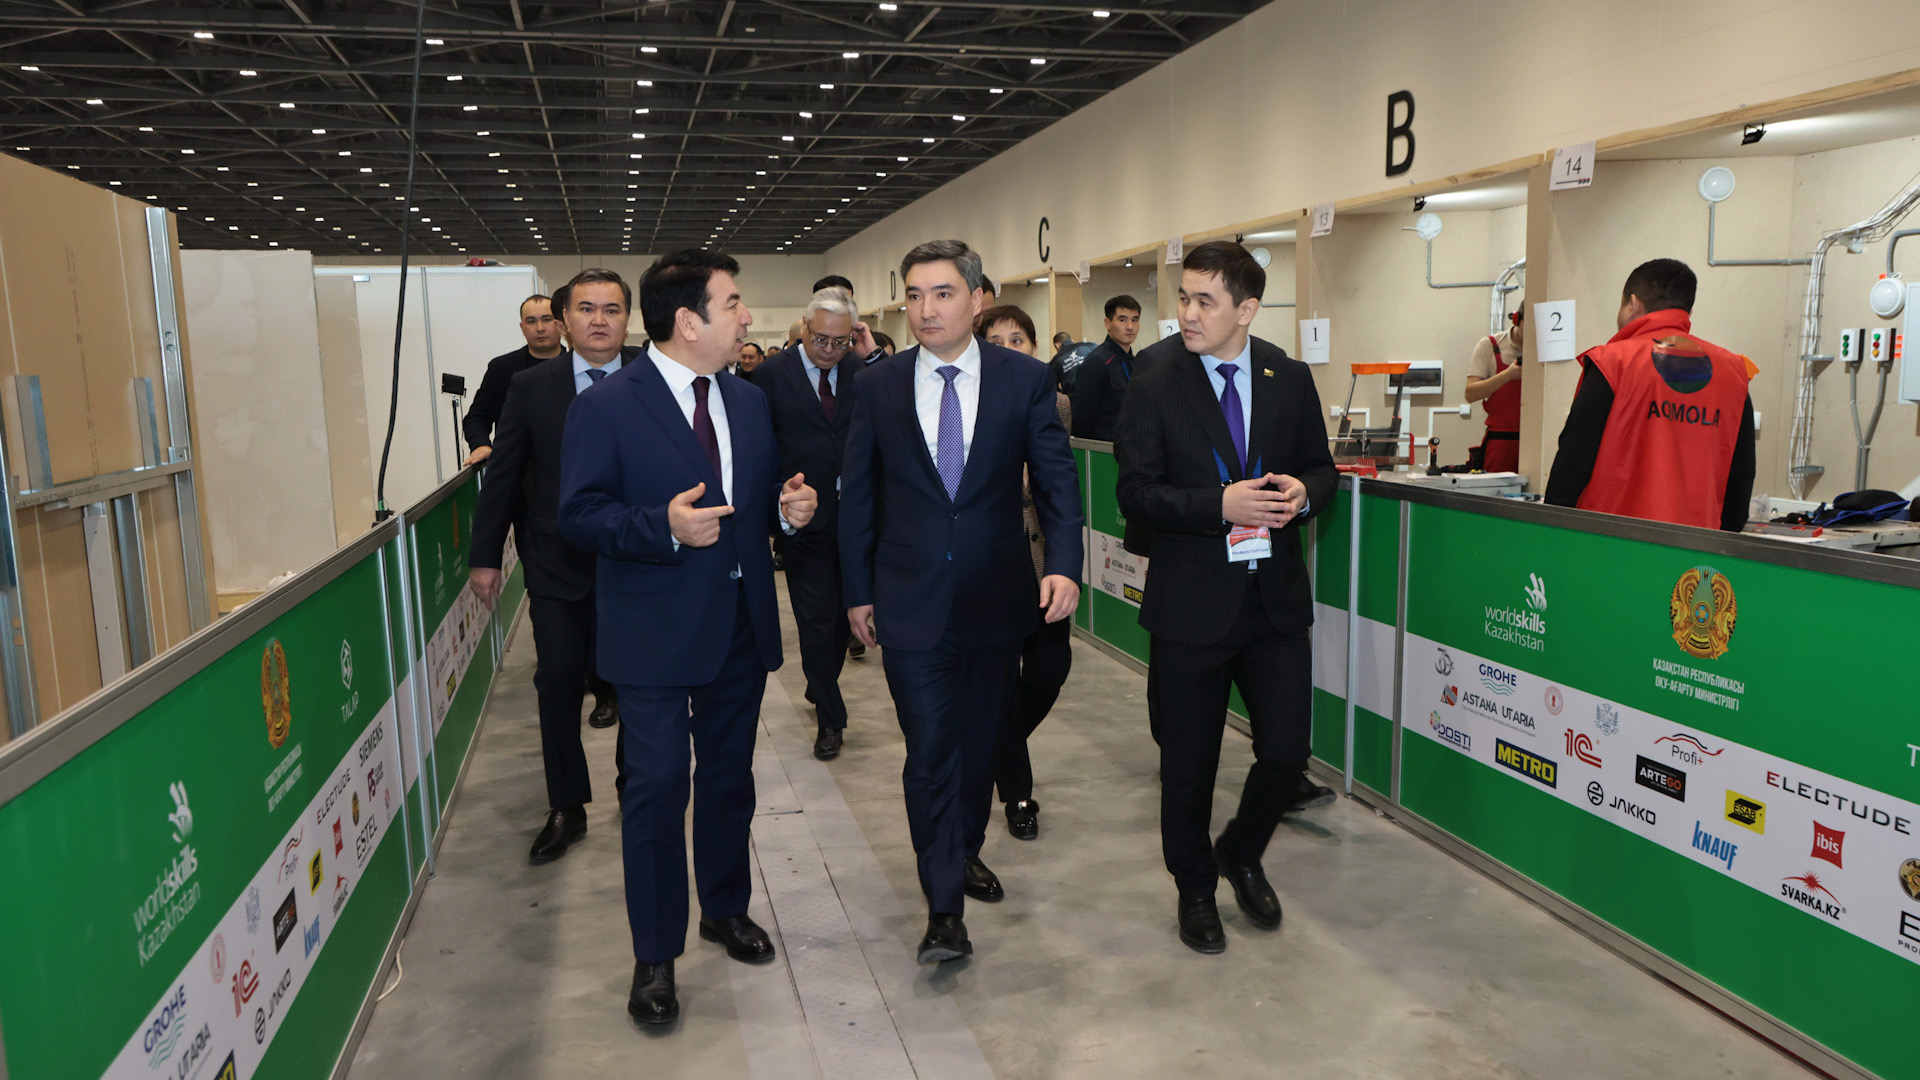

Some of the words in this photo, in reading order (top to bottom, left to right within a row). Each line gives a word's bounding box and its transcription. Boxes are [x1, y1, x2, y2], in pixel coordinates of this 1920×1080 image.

[1386, 90, 1415, 177] B
[1565, 156, 1582, 176] 14
[1319, 212, 1329, 227] 13
[1038, 216, 1050, 263] C
[1172, 244, 1179, 256] 12
[1313, 327, 1318, 342] 1
[1550, 312, 1563, 331] 2
[1647, 401, 1720, 428] AQMOLA
[1124, 586, 1143, 602] METRO
[1485, 606, 1546, 634] worldskills
[1484, 621, 1544, 652] Kazakhstan
[1479, 664, 1517, 687] GROHE
[1462, 691, 1497, 715] ASTANA
[1502, 706, 1535, 730] UTARIA
[359, 721, 383, 767] SIEMENS
[1498, 743, 1555, 783] METRO
[1640, 766, 1682, 790] ARTEGO
[317, 768, 351, 825] ELECTUDE
[1609, 796, 1656, 825] JAKKO
[1733, 802, 1756, 820] ESAB
[1766, 770, 1911, 835] ELECTUDE
[356, 813, 378, 861] ESTEL
[1816, 832, 1839, 854] ibis
[133, 843, 198, 933] worldskills
[138, 882, 200, 968] Kazakhstan
[143, 984, 187, 1054] GROHE
